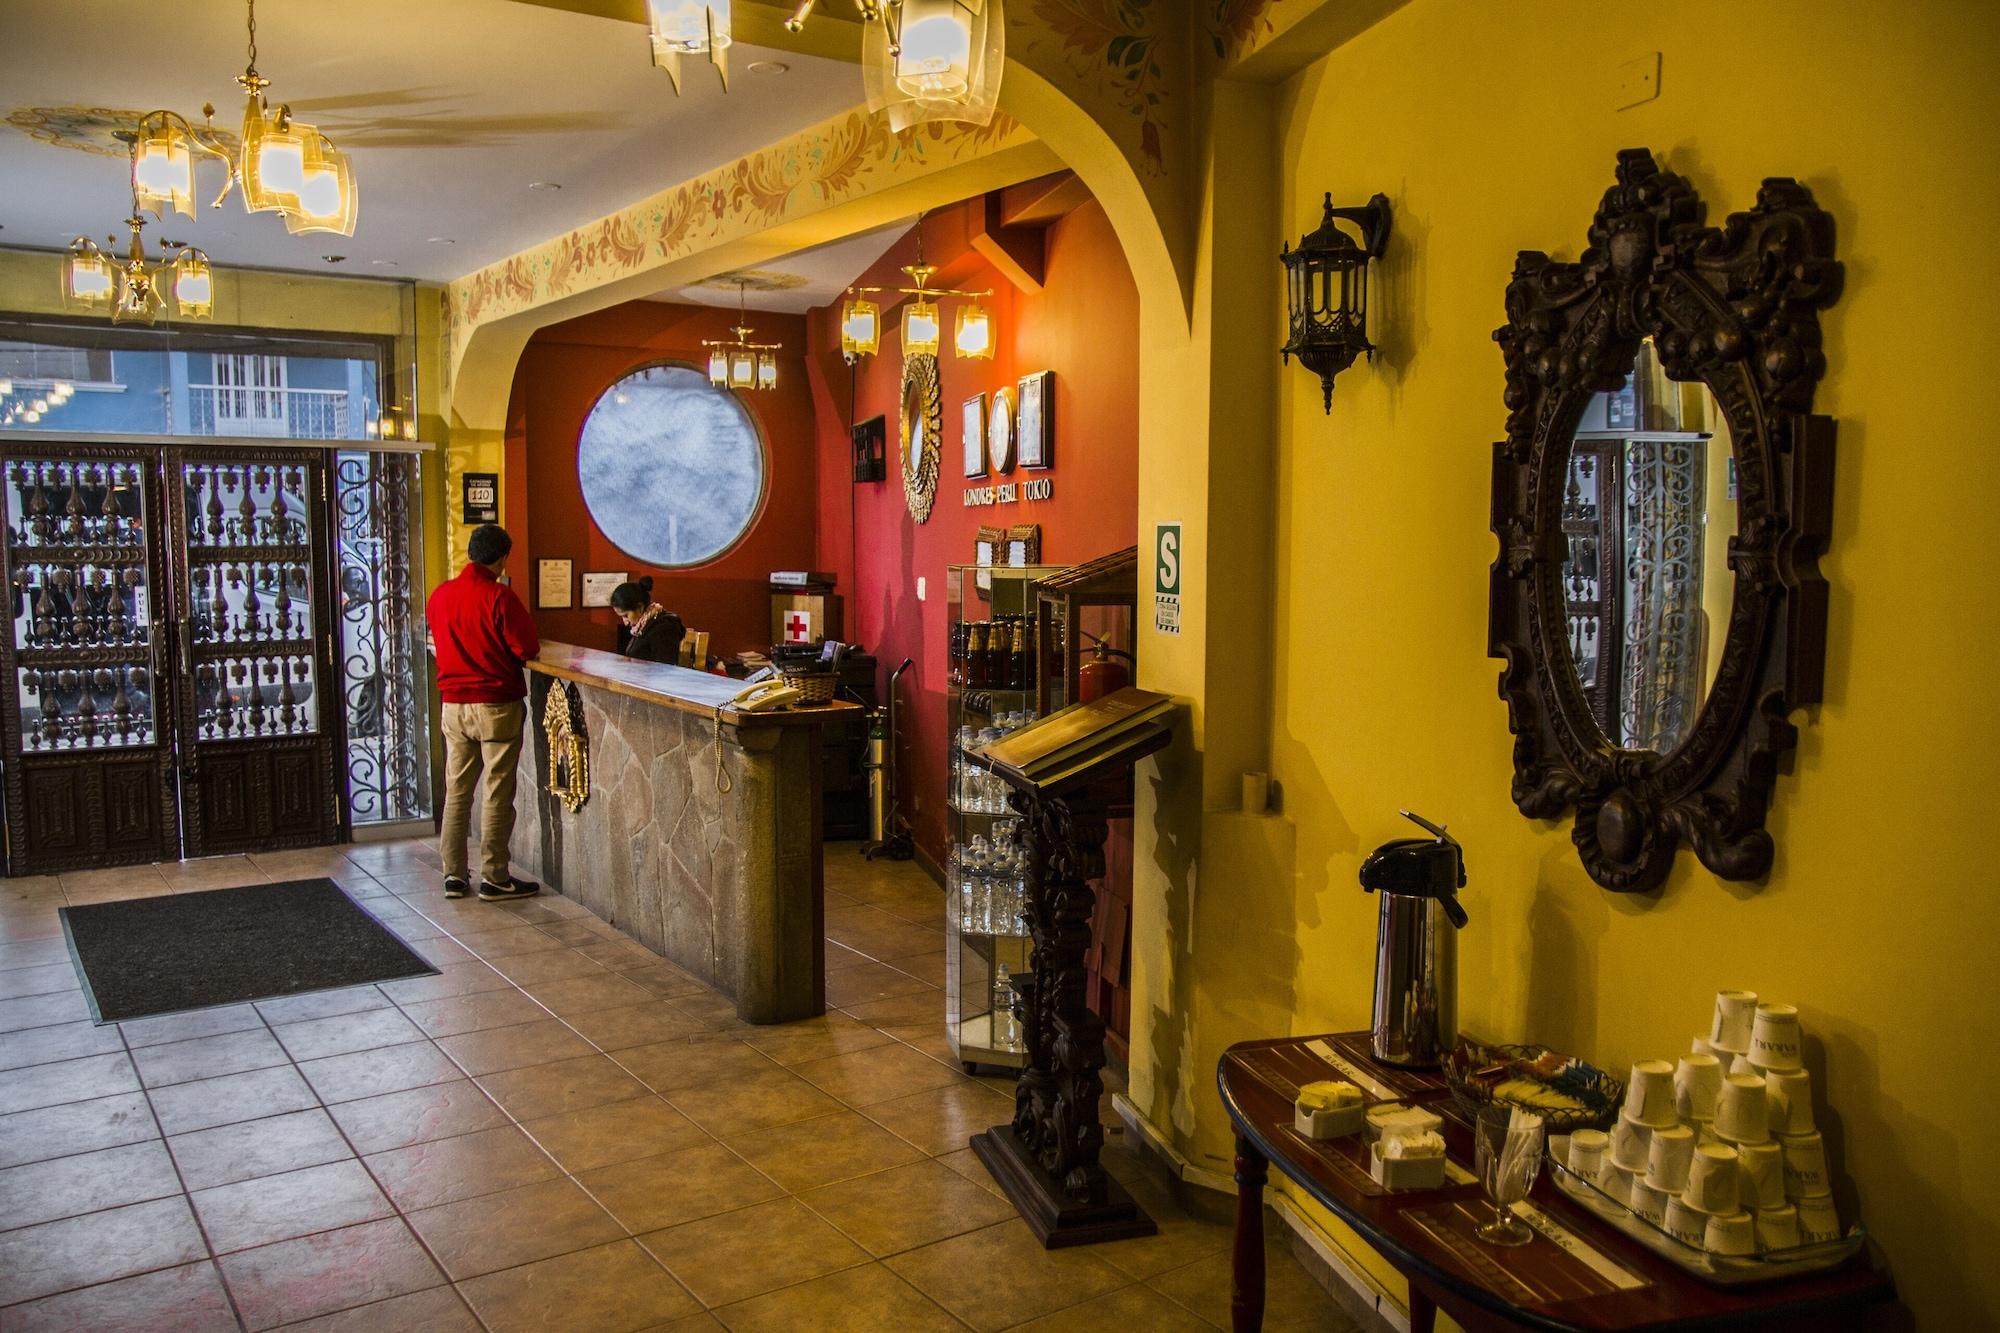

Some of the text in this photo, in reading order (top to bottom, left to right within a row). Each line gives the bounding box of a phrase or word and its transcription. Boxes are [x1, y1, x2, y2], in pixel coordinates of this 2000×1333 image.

[471, 489, 490, 500] 110
[964, 487, 993, 506] LONDRES
[1023, 479, 1051, 500] TOKIO
[1159, 531, 1177, 589] S
